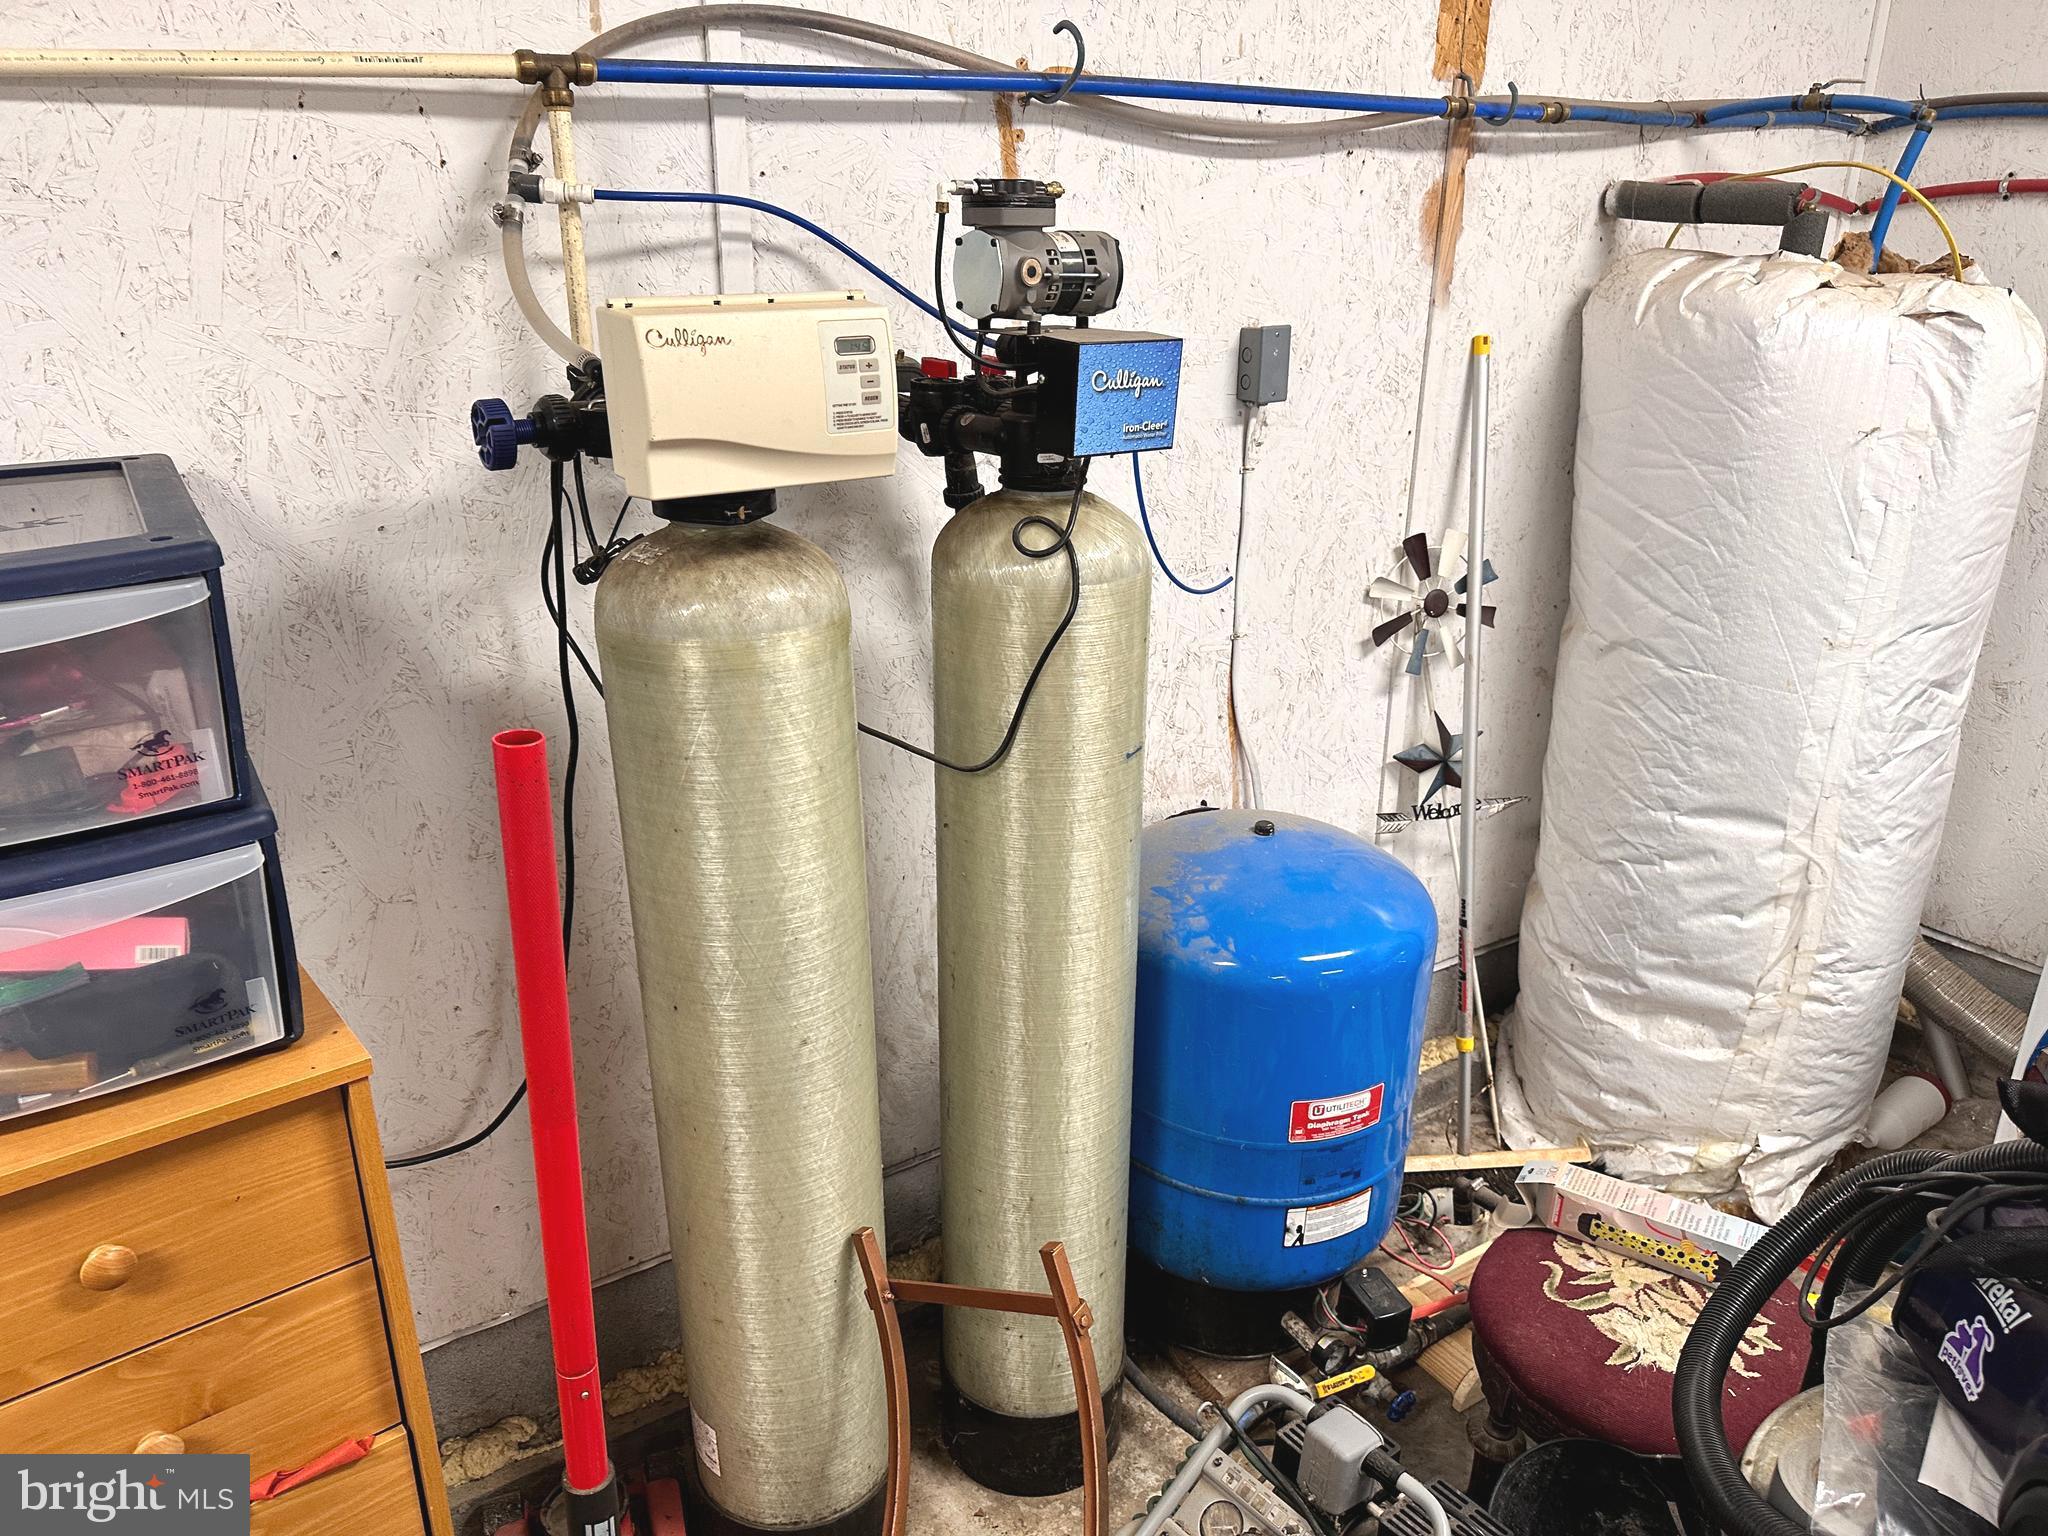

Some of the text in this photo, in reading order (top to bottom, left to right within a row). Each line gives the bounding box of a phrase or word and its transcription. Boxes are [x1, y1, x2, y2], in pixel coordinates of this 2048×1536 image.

[645, 327, 732, 357] Culligan
[1091, 368, 1164, 399] Culligan
[138, 781, 200, 799] SmartPak.com
[1307, 1117, 1351, 1129] Diaphragm
[1976, 1278, 2033, 1334] reka!
